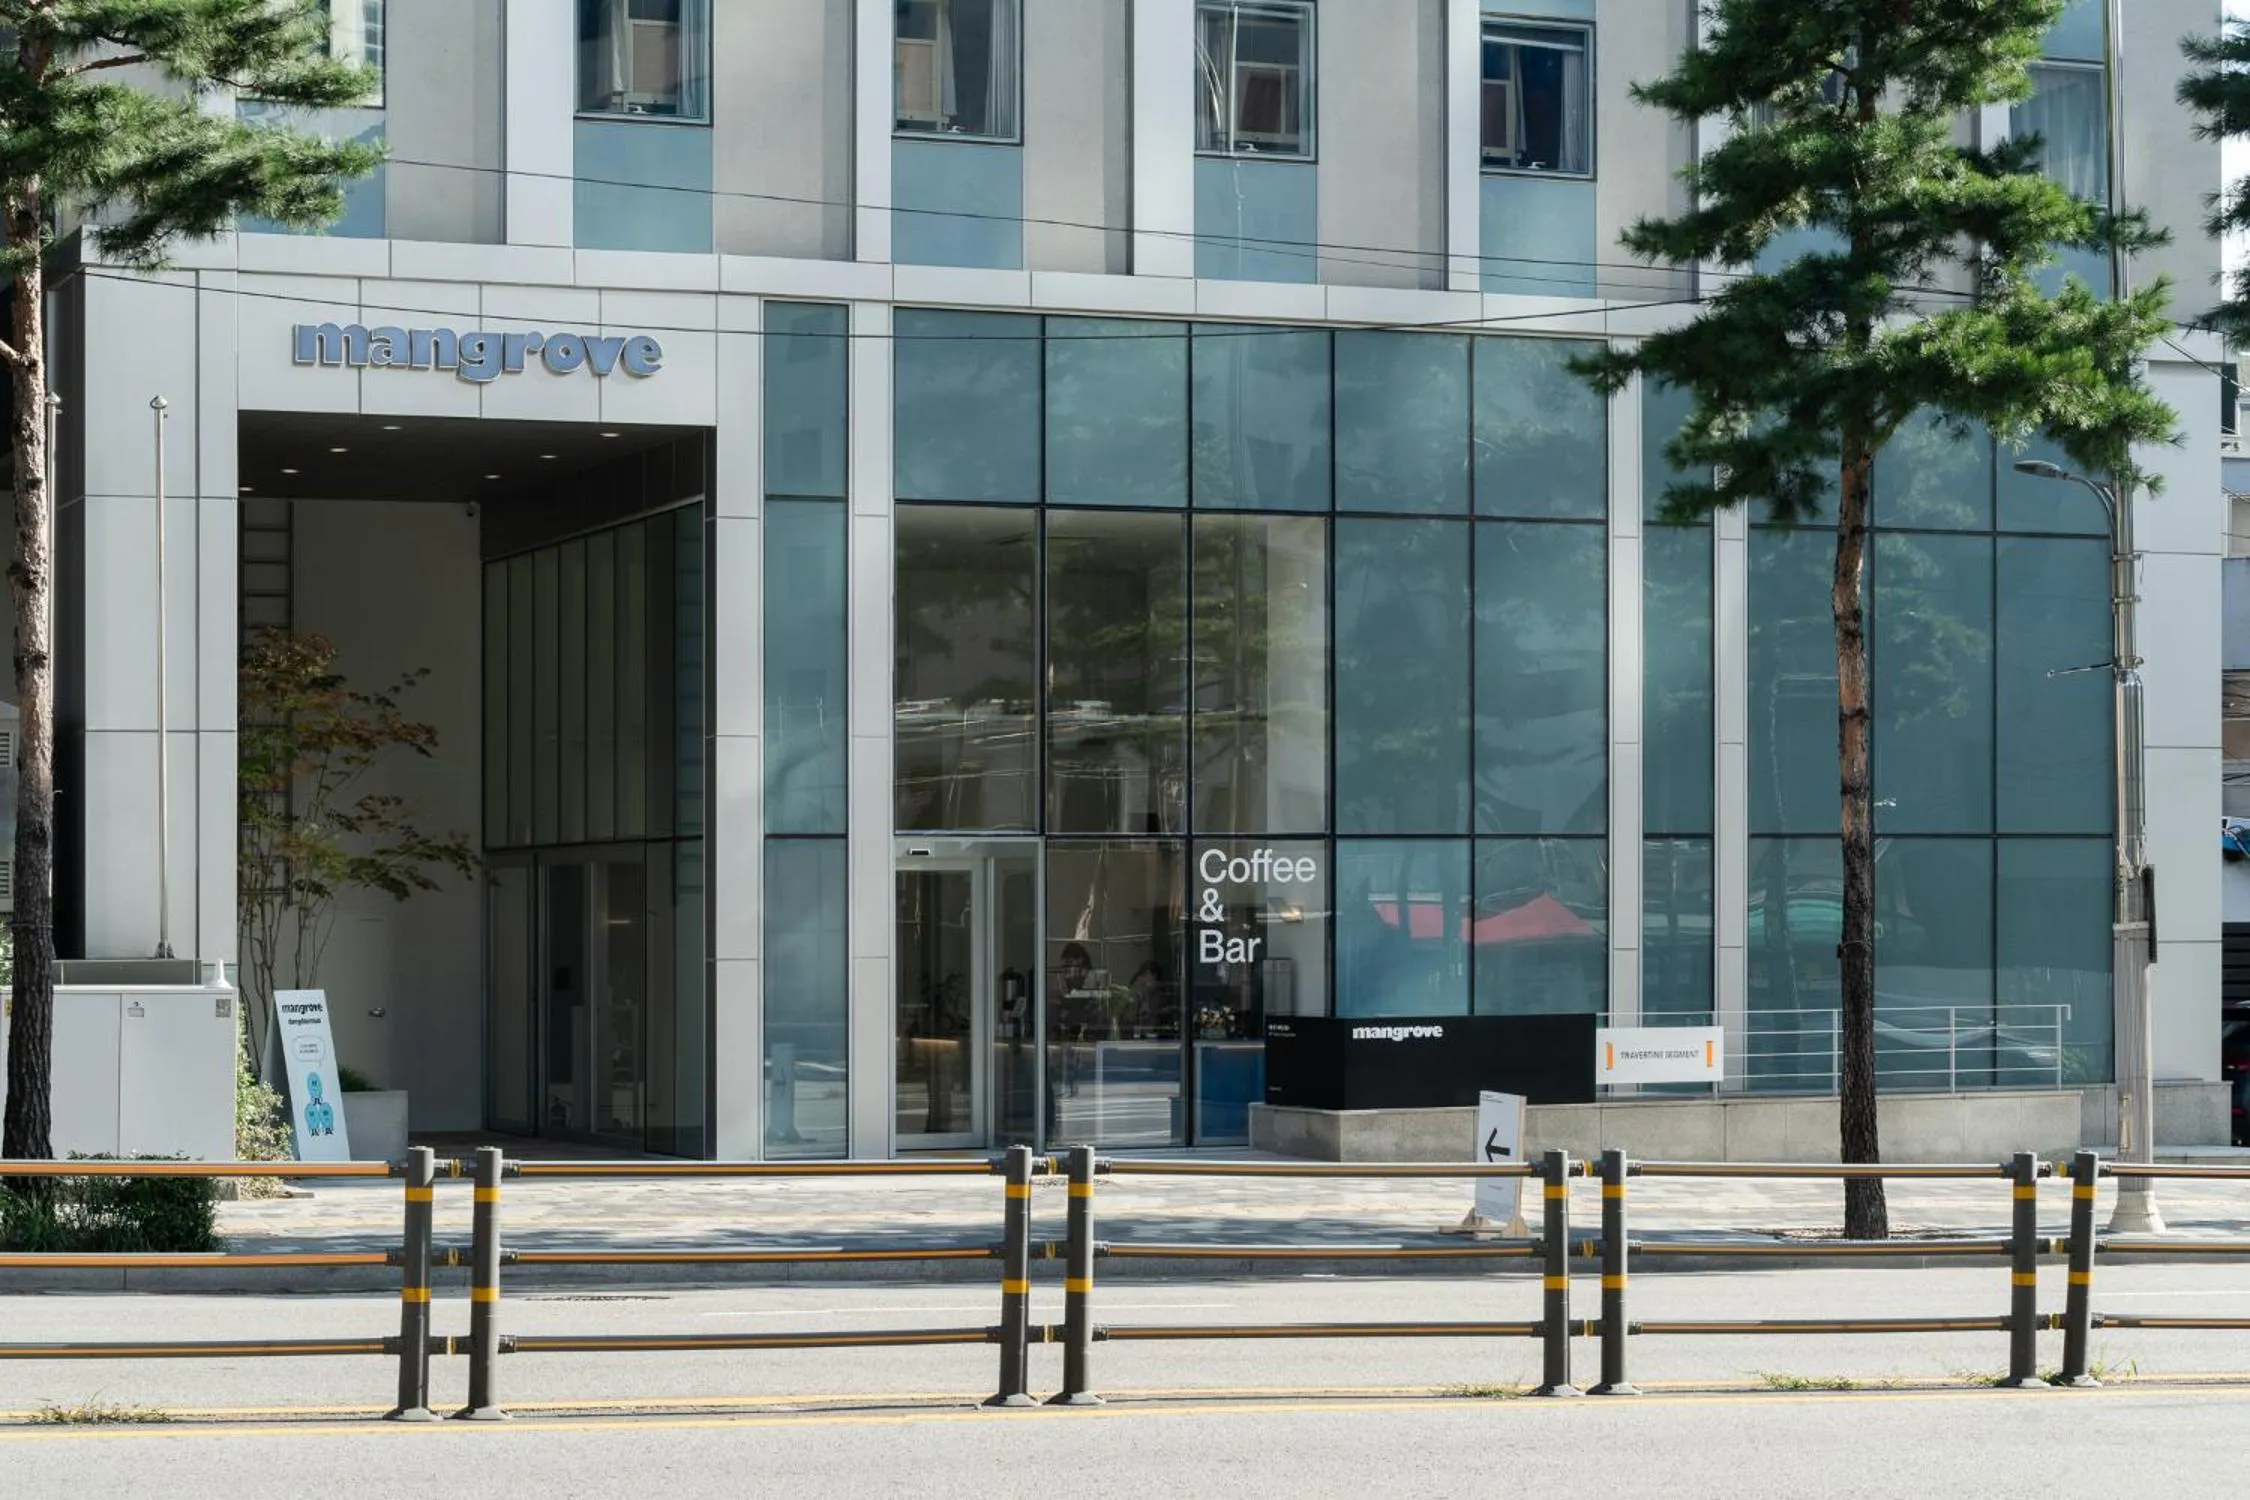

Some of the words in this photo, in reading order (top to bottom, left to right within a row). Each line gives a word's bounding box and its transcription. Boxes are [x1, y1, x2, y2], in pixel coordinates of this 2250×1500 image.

[292, 322, 663, 383] mangrove
[1200, 849, 1316, 883] Coffee
[1200, 888, 1224, 922] &
[1200, 930, 1261, 963] Bar
[281, 1004, 323, 1015] mangrove
[1352, 1025, 1443, 1042] mangrove
